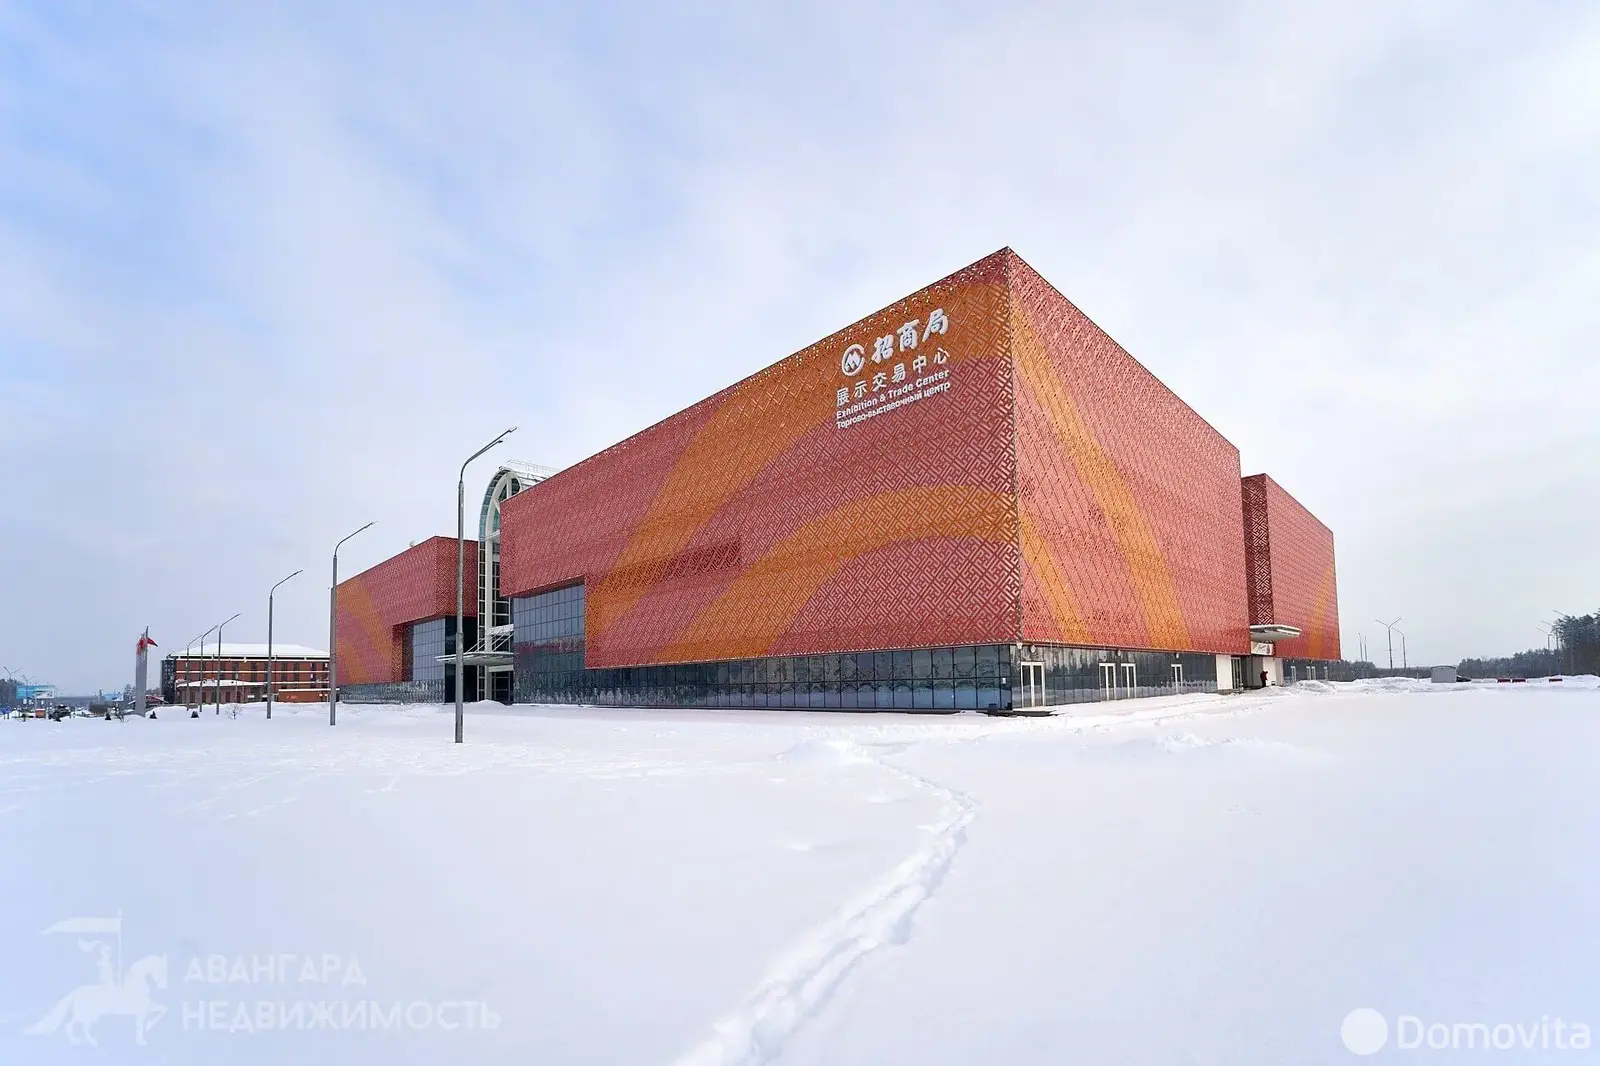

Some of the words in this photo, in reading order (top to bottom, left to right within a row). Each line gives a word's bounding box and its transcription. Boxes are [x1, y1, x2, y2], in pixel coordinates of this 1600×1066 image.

[872, 308, 949, 364] 招商局
[837, 347, 950, 407] 展示交易中心
[837, 398, 877, 419] Exhibition
[879, 393, 886, 402] &
[888, 383, 914, 399] Trade
[916, 369, 950, 388] Center
[836, 390, 922, 429] Торгово-выставочный
[924, 382, 951, 397] центр
